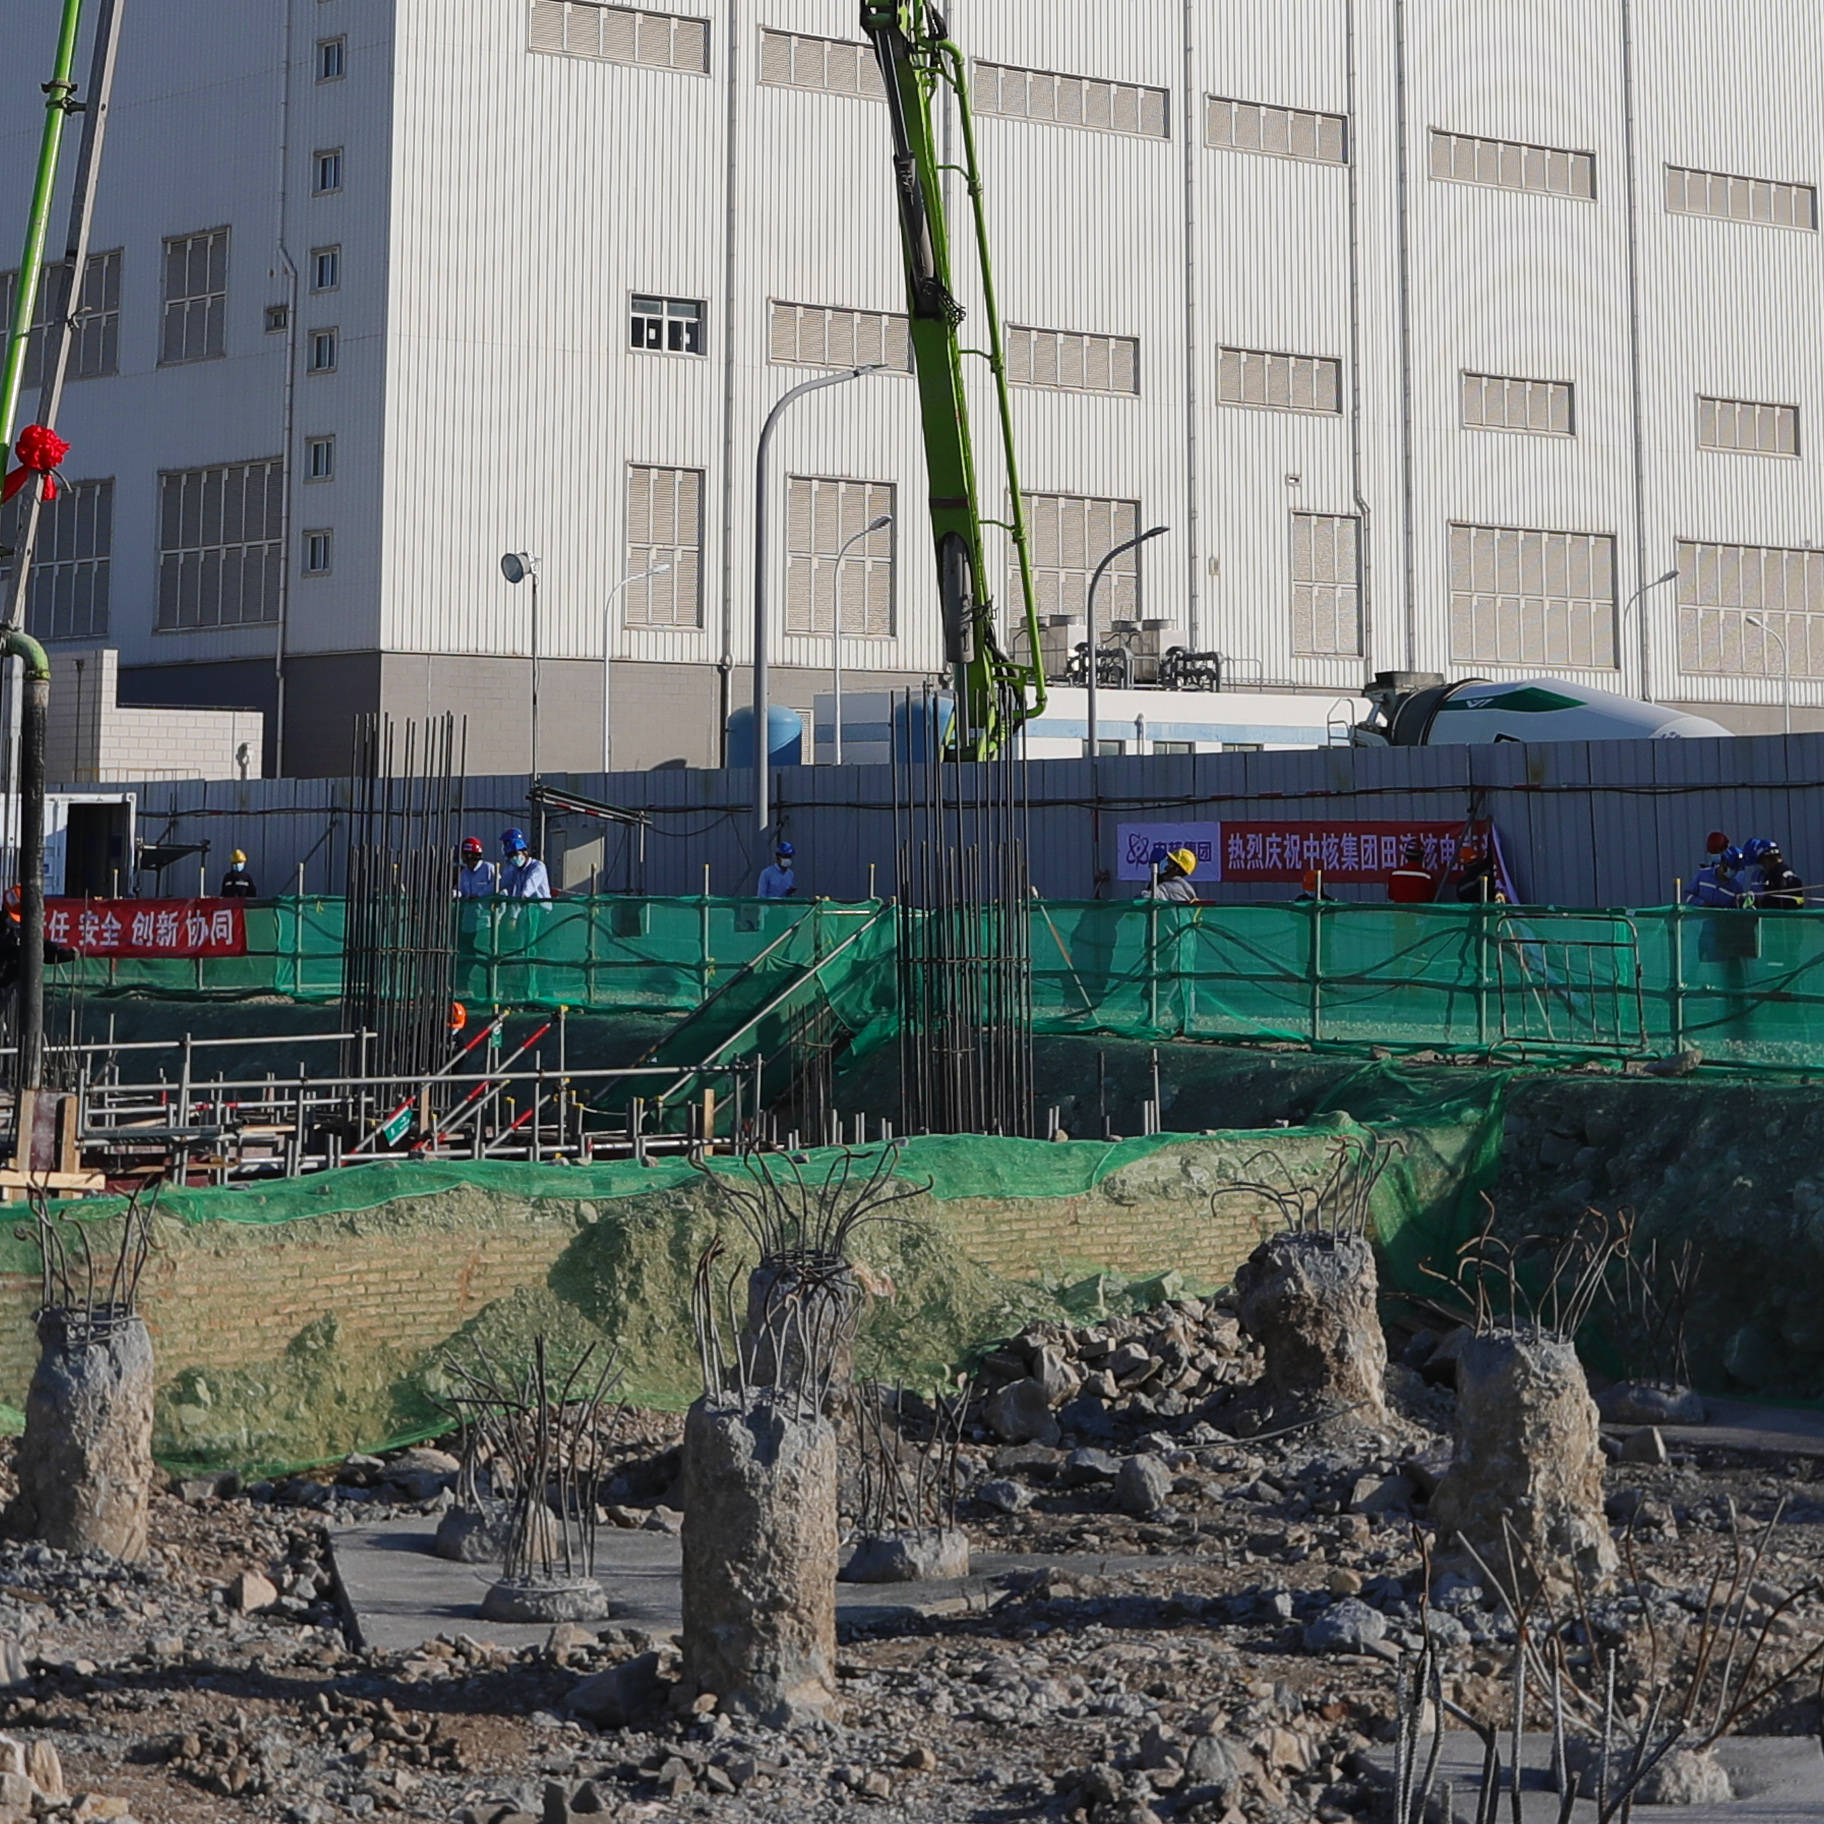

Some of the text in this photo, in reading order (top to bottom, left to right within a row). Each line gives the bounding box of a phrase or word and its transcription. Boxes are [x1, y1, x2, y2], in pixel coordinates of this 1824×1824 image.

[78, 909, 122, 947] 安全
[131, 910, 179, 947] 创新
[186, 908, 233, 947] 协同
